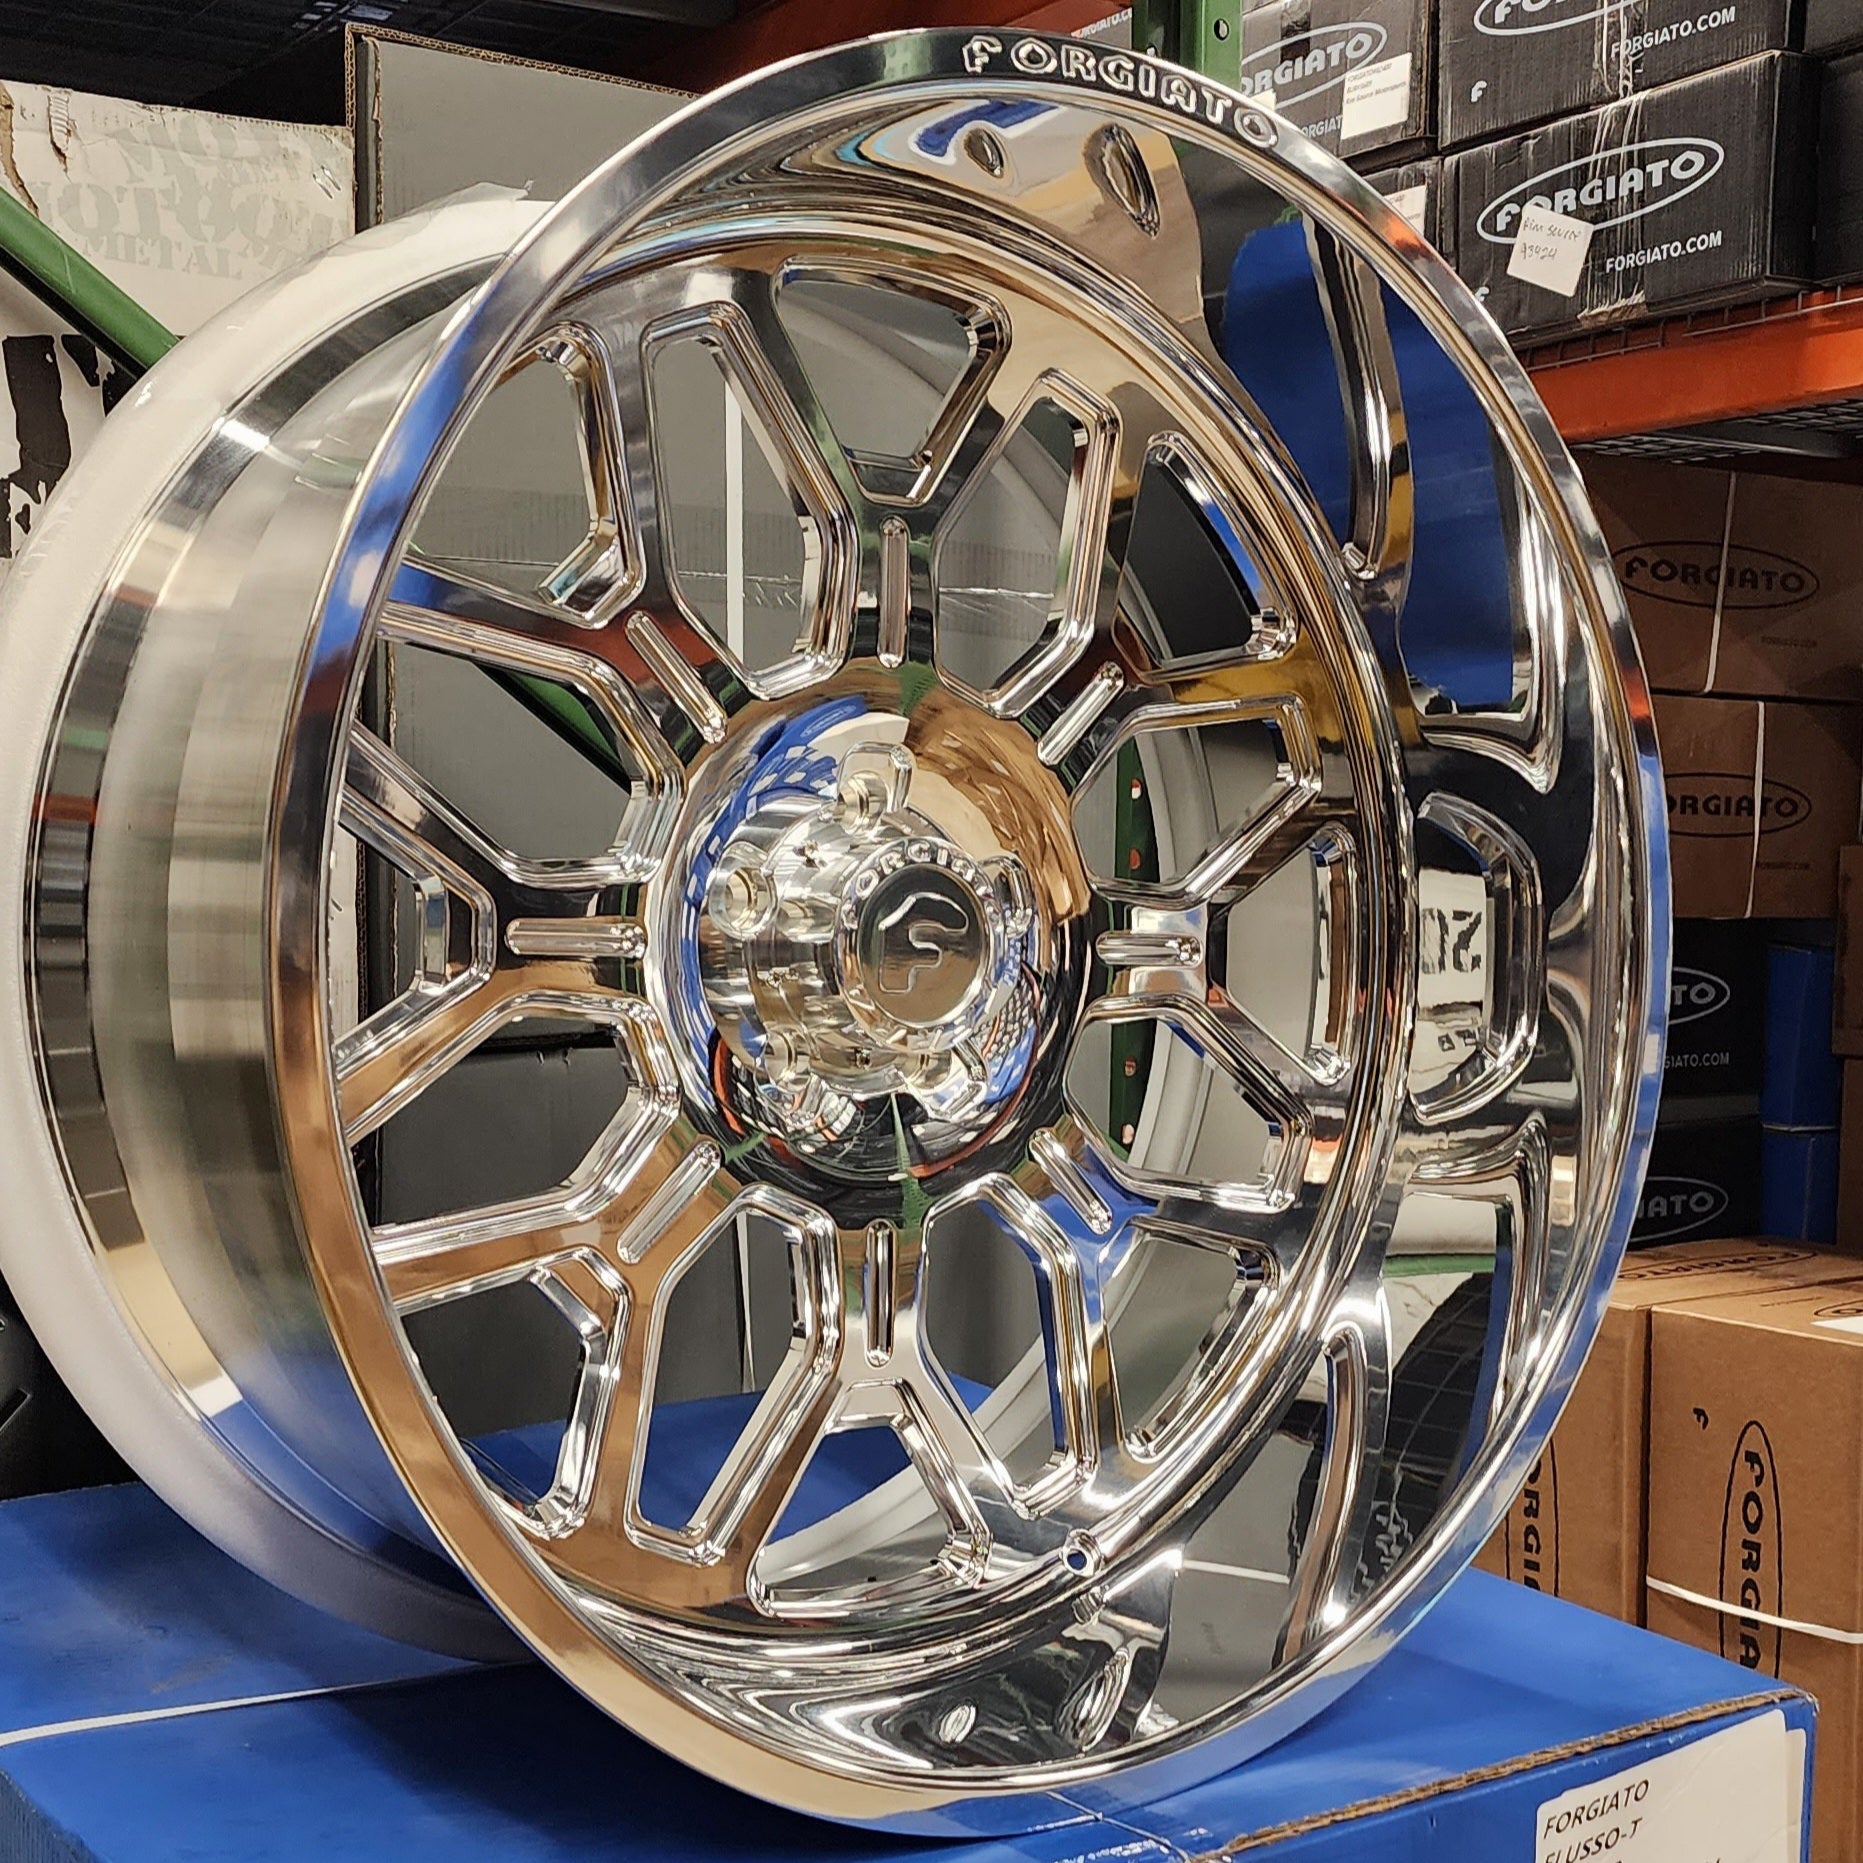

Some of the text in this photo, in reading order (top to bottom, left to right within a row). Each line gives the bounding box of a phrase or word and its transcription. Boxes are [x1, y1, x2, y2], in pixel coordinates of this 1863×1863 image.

[1610, 6, 1736, 60] FORGIATO.COM
[962, 34, 1277, 148] FORGIATO
[1605, 230, 1723, 274] FORGIATO.COM
[1624, 556, 1805, 594] FORGIATO
[1543, 1779, 1650, 1840] FORGIATO
